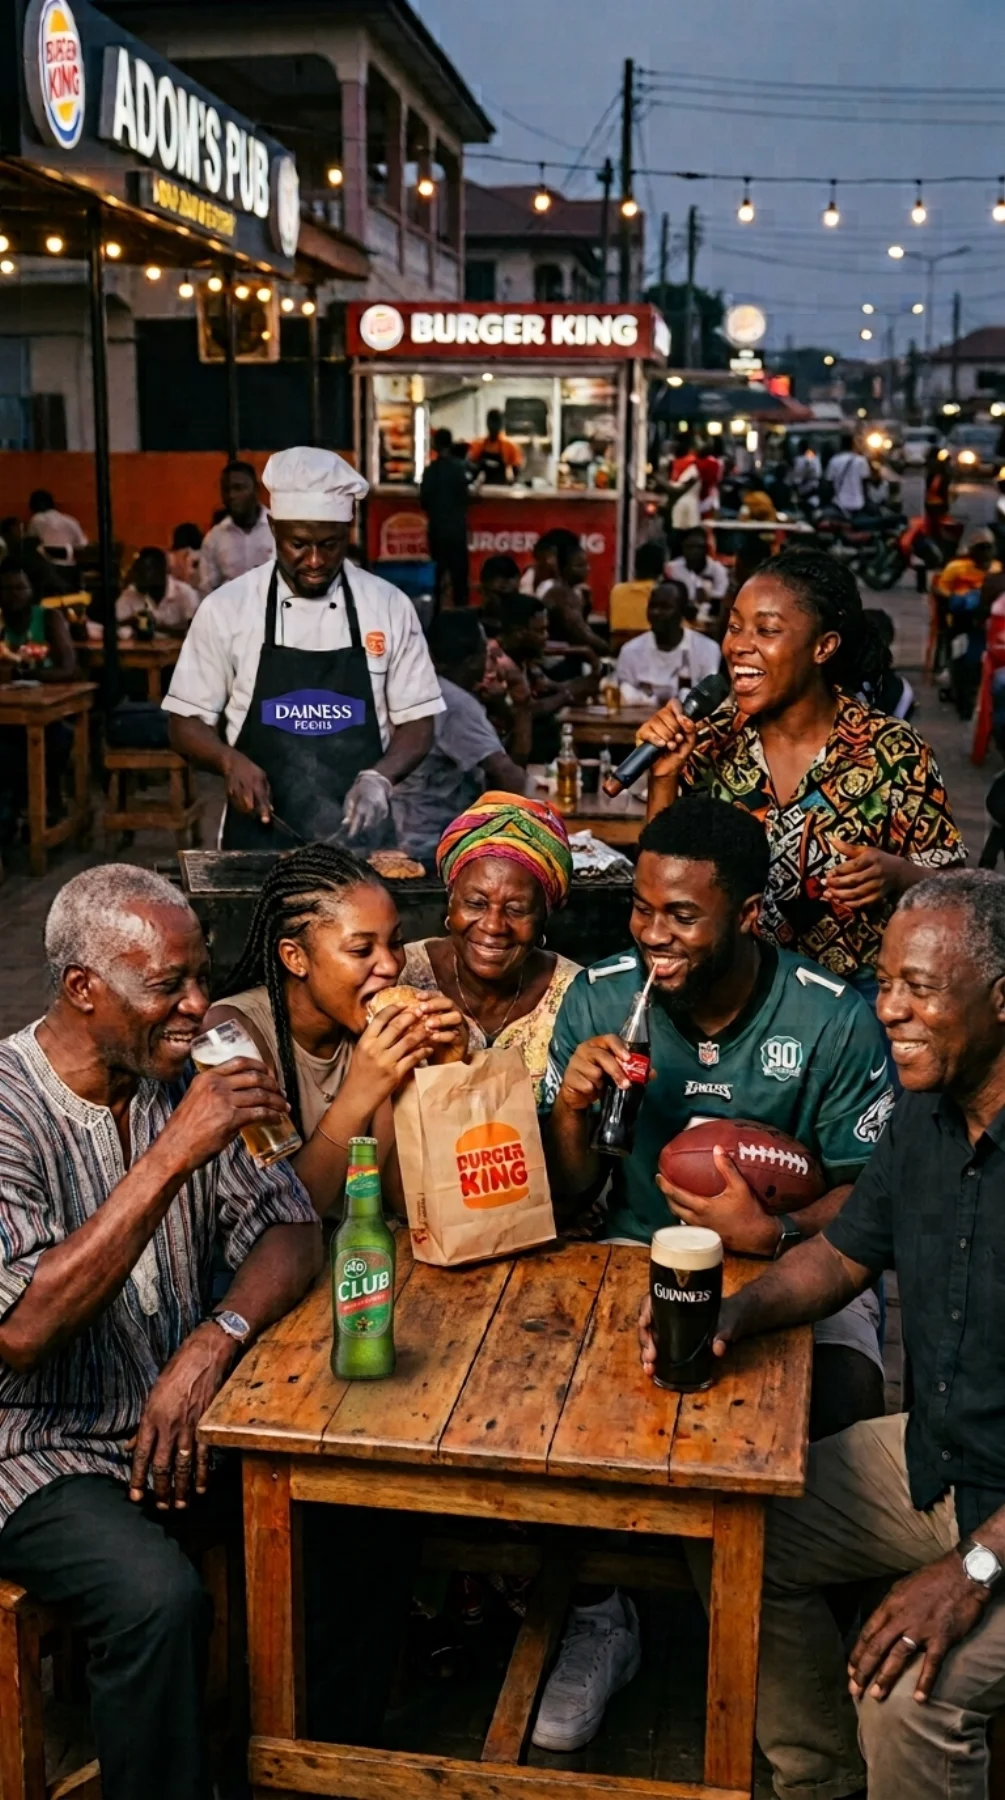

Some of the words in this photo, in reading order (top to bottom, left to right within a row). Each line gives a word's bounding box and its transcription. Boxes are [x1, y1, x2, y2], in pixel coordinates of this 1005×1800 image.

[113, 46, 222, 194] ADOM'S
[225, 120, 269, 219] PUB
[410, 313, 546, 345] BURGER
[551, 314, 638, 346] KING
[467, 530, 541, 552] URGER
[587, 956, 637, 985] 1
[795, 966, 846, 998] 1
[767, 1041, 797, 1069] 90
[460, 1160, 528, 1197] KING
[338, 1271, 390, 1302] CLUB
